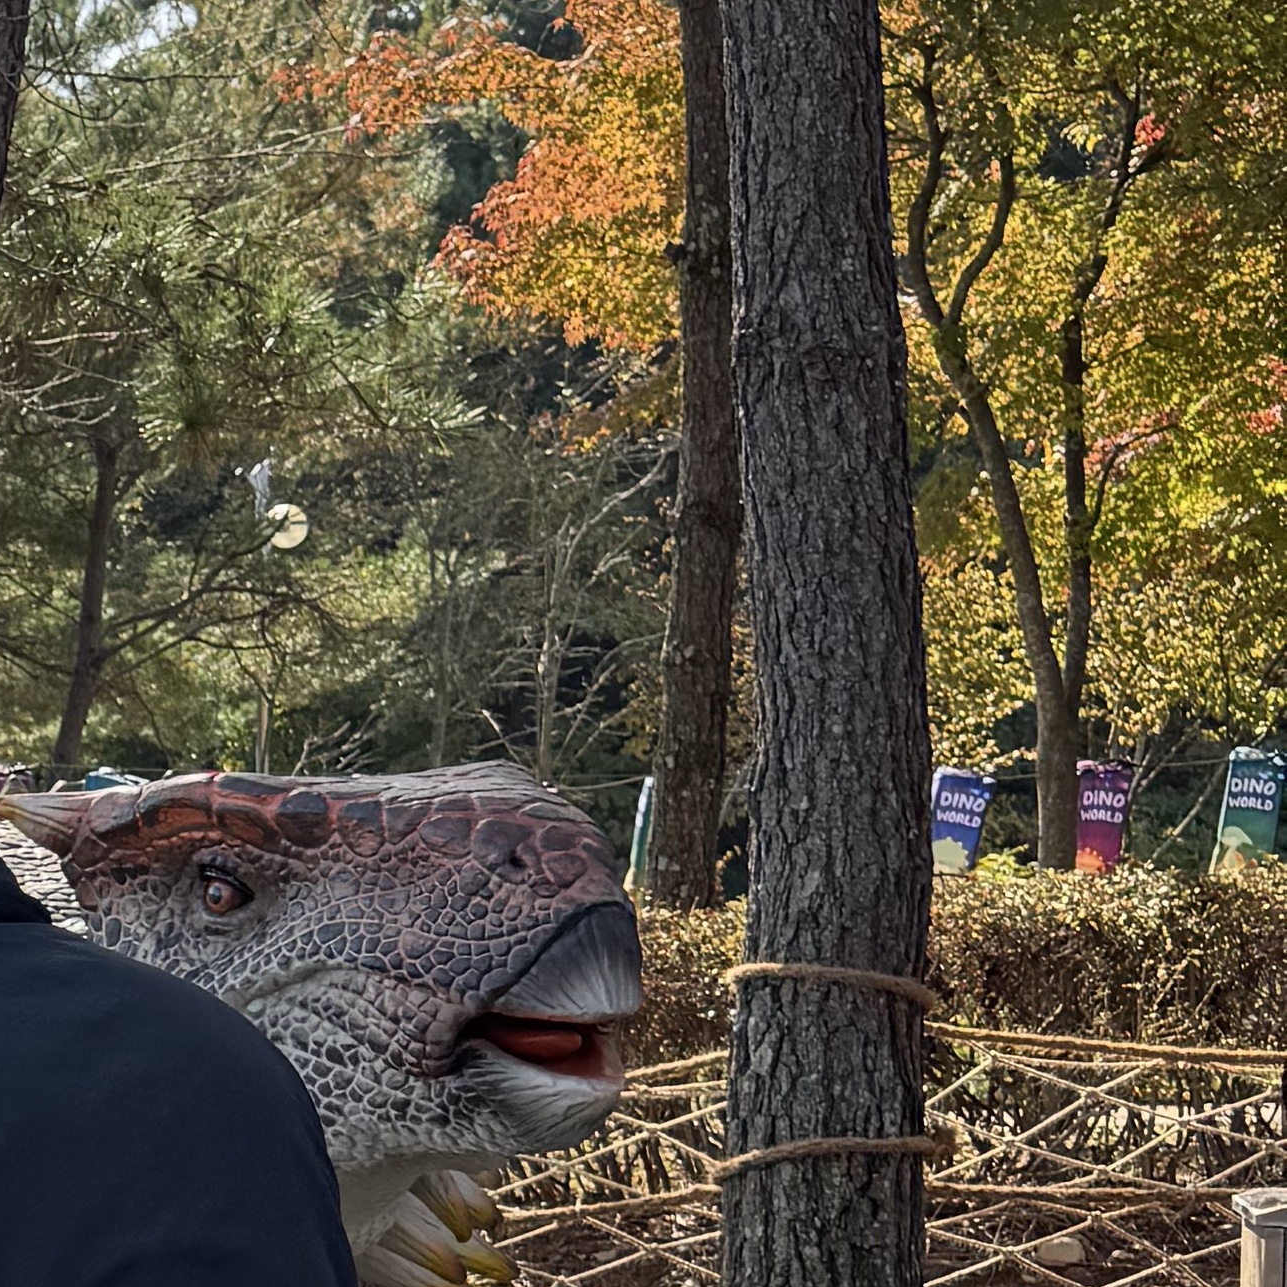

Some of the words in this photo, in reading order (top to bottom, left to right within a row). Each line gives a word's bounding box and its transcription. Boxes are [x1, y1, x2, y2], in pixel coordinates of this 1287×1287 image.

[1231, 777, 1277, 796] DINO
[939, 790, 986, 812] DINO
[1082, 789, 1125, 809] DINO
[1228, 795, 1274, 811] WORLD
[936, 809, 981, 828] WORLD
[1080, 809, 1123, 825] WORLD
